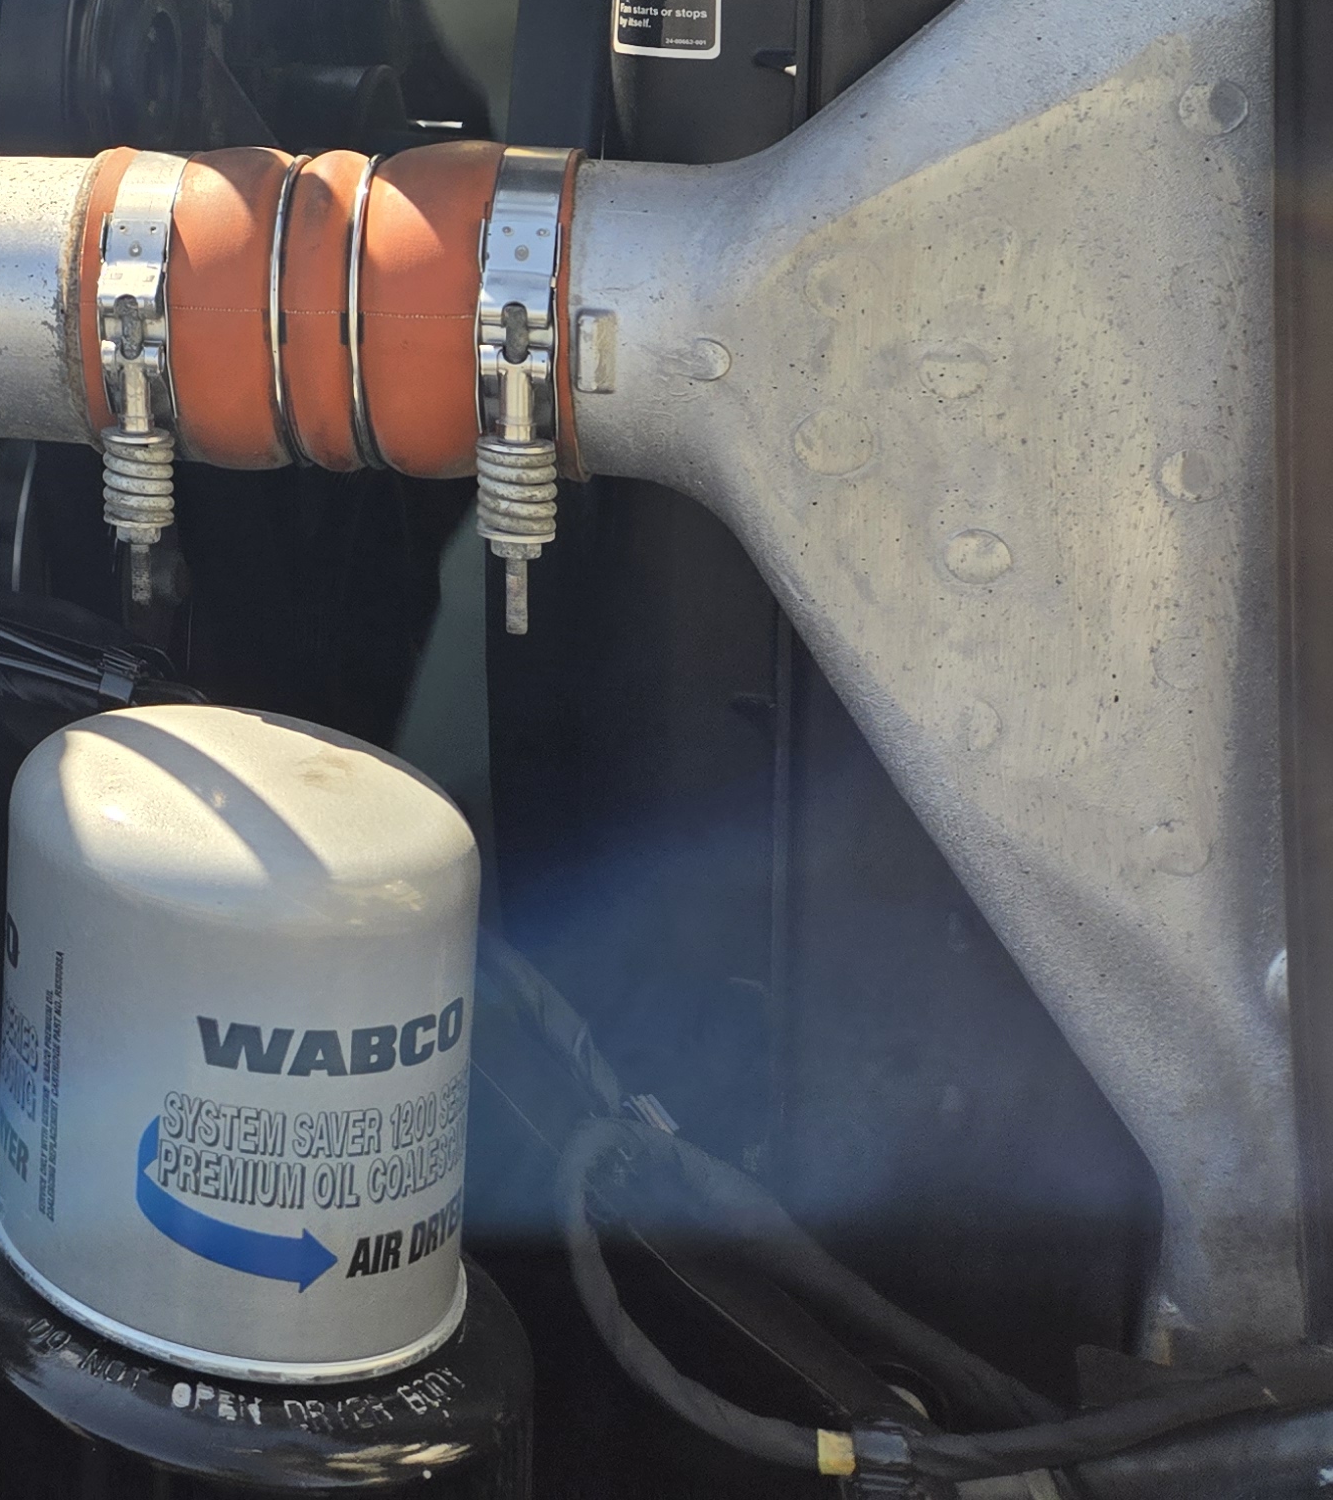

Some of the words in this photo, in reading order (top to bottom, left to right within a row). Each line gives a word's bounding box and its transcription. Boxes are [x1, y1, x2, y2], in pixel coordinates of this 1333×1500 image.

[620, 16, 627, 28] by
[621, 2, 632, 13] Fan
[633, 6, 658, 16] starts
[660, 9, 673, 17] or
[675, 9, 708, 20] stops
[52, 1016, 62, 1043] PART
[196, 997, 465, 1077] WABCO
[162, 1091, 285, 1157] SYSTEM
[291, 1107, 383, 1159] SAVER
[389, 1091, 437, 1150] 1200
[158, 1138, 307, 1209] PREMIUM
[312, 1160, 361, 1210] OIL
[345, 1229, 403, 1278] AIR
[28, 1318, 72, 1351] DO
[79, 1348, 148, 1390] NOT
[171, 1381, 264, 1426] OPEN
